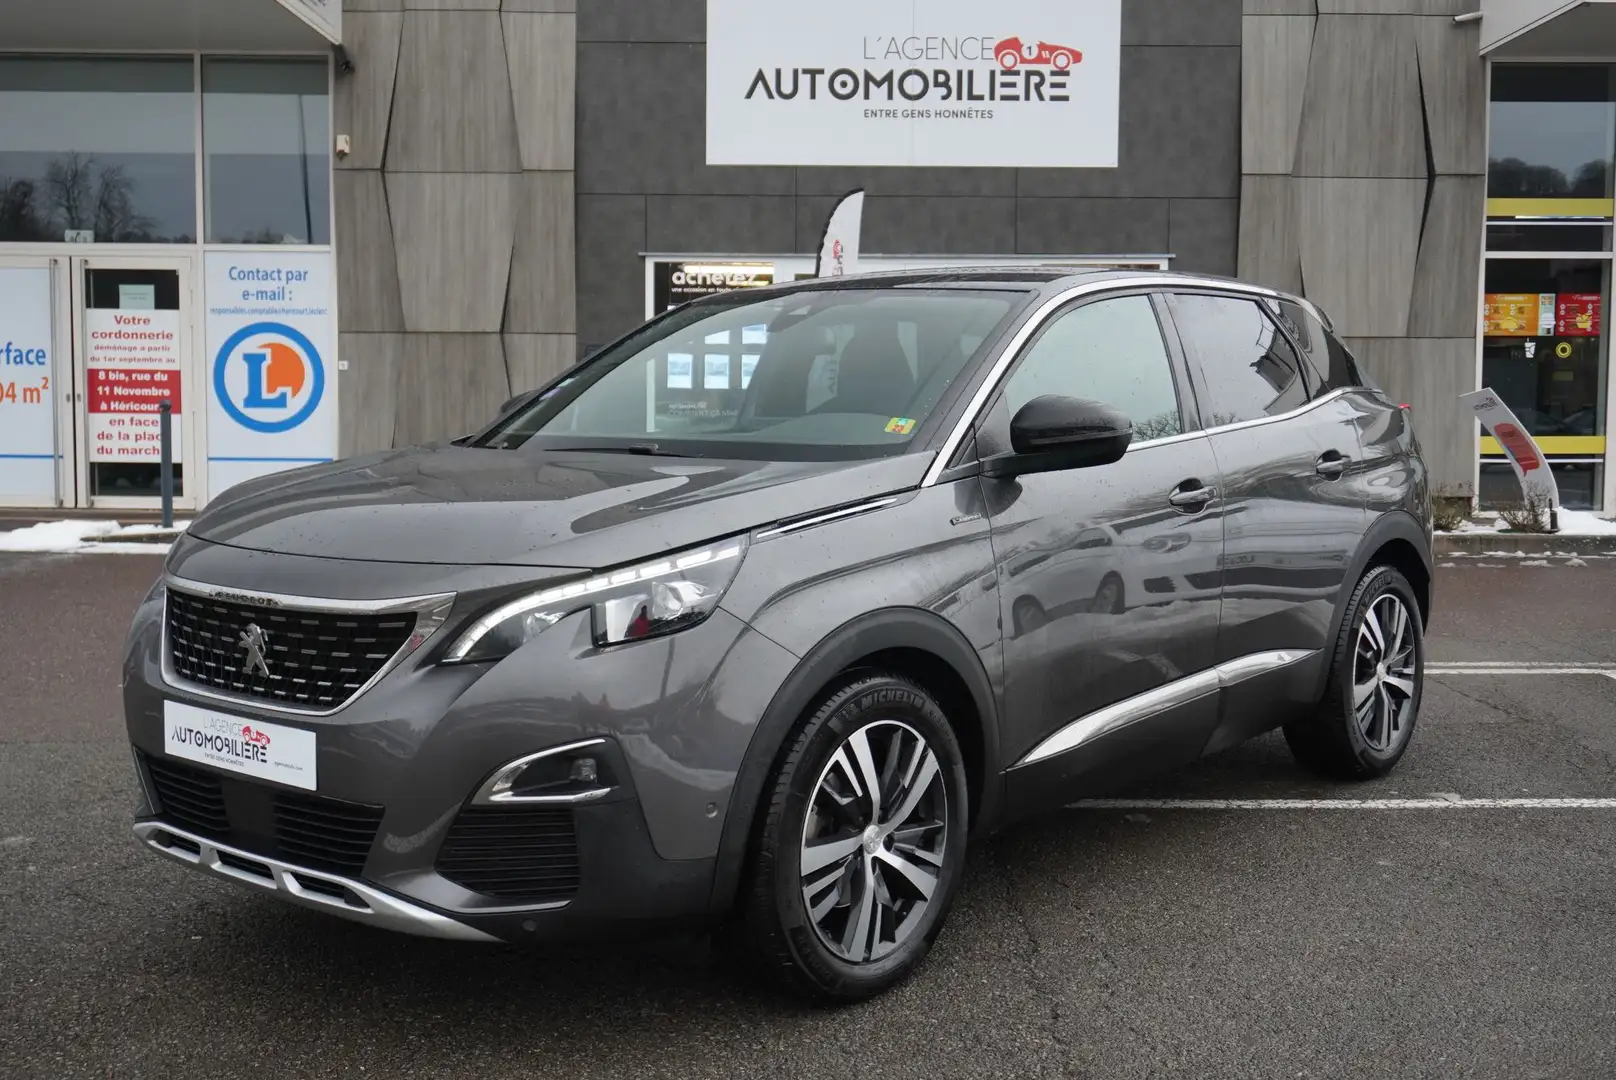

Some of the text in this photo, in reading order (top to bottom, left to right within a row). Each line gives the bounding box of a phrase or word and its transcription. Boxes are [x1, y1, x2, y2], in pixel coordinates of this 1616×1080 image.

[863, 36, 995, 60] L'AGENCE
[864, 107, 994, 119] ENTRE GENS HONNÊTES
[228, 266, 308, 284] Contact par
[671, 271, 756, 285] achetez
[242, 286, 285, 301] e-mail
[114, 315, 150, 325] Votre
[91, 330, 173, 340] cordonnerie
[147, 344, 171, 353] partir
[118, 356, 163, 364] septembre
[98, 371, 168, 383] 8 bis, rue du
[97, 386, 171, 397] 11 Novembre
[110, 400, 161, 412] Héricour
[109, 416, 159, 427] en face
[96, 430, 161, 443] de la plac
[96, 445, 160, 455] du march
[214, 591, 273, 606] PEUGEOT
[861, 690, 924, 710] MICHELIN
